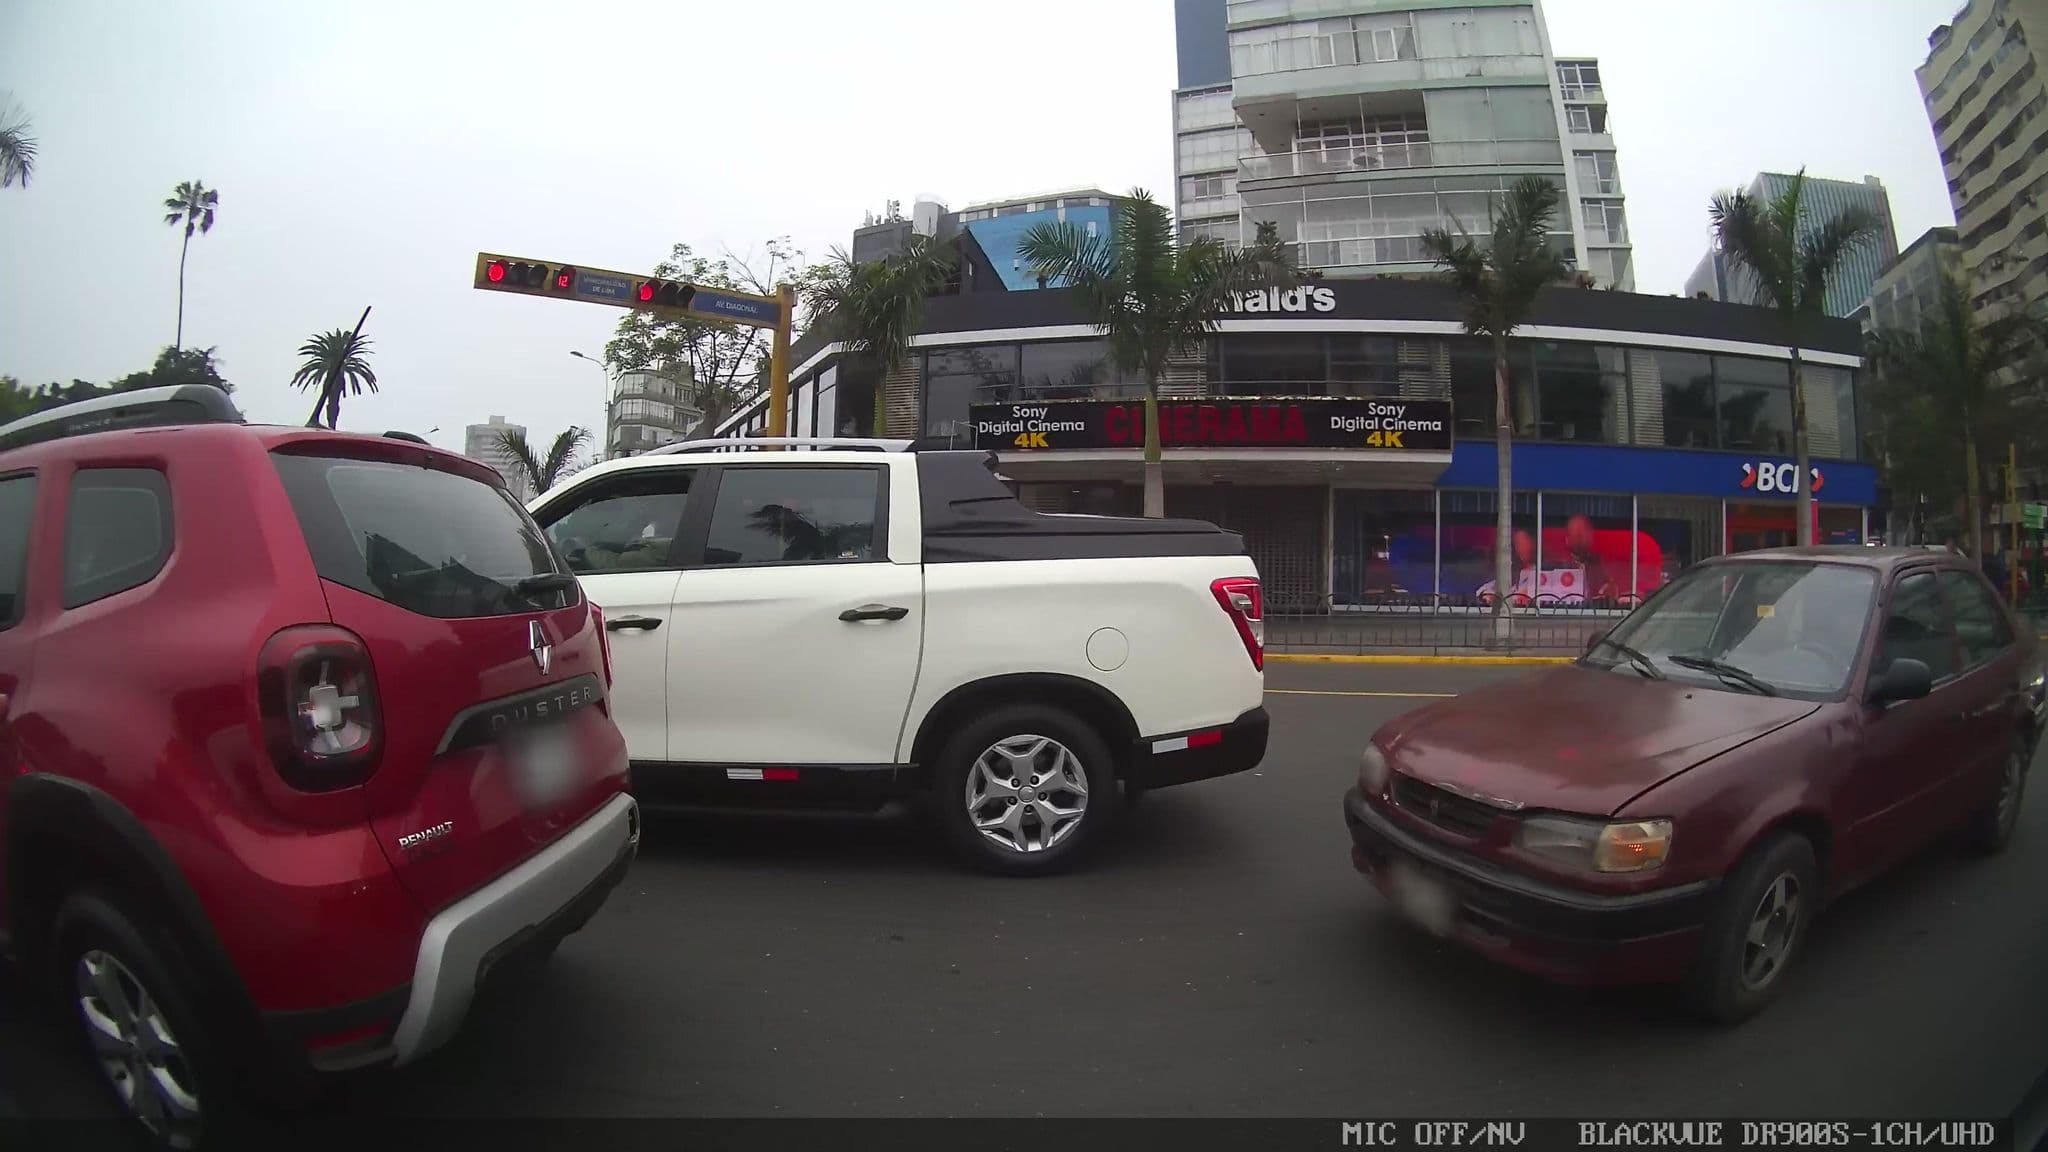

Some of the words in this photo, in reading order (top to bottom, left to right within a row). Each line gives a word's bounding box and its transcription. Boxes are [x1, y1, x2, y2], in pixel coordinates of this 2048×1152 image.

[726, 302, 758, 314] DIAGONAL
[1012, 405, 1048, 419] Sony
[1368, 402, 1406, 418] Sony
[979, 420, 1024, 436] Digital
[1027, 420, 1085, 432] Cinema
[1331, 417, 1379, 432] Digital
[1382, 417, 1442, 432] Cinema
[1014, 432, 1049, 448] 4K
[1366, 431, 1404, 448] 4K
[491, 685, 592, 731] DUSTER
[398, 821, 454, 849] RENAULT
